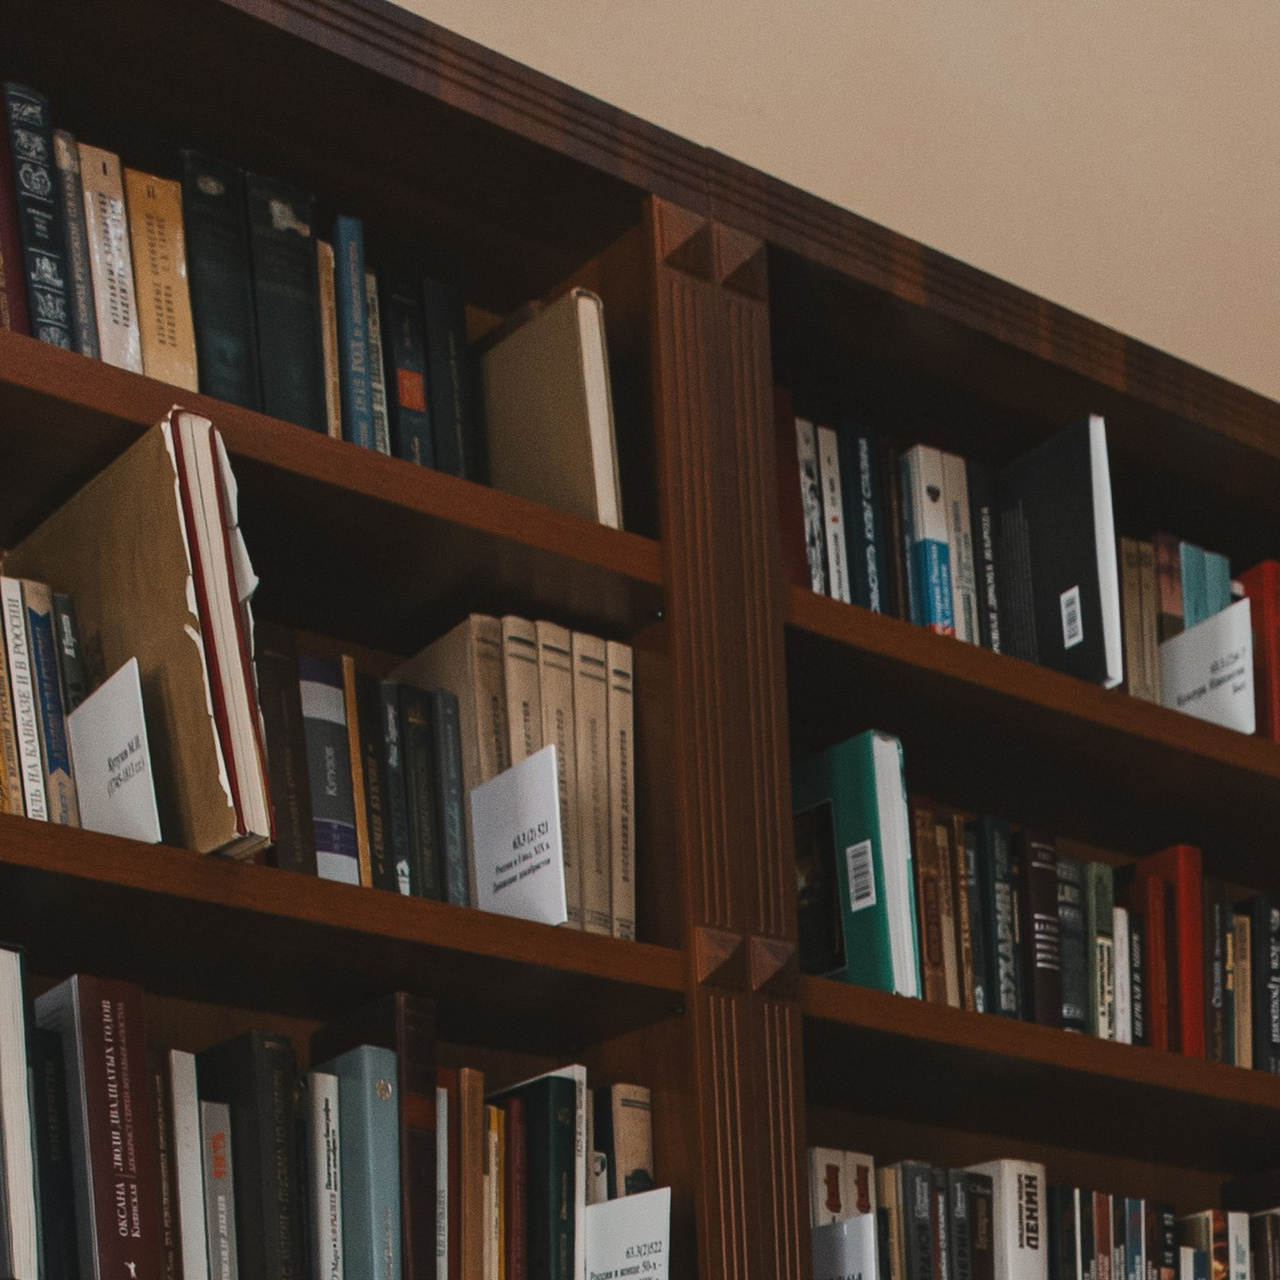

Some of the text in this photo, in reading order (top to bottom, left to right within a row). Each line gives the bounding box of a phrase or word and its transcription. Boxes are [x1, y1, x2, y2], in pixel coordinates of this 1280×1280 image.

[8, 598, 25, 656] РОССИИ
[13, 661, 27, 671] В
[15, 692, 37, 757] КАВКАЗЕ
[26, 764, 40, 783] НА
[995, 882, 1016, 1010] БУХАРИН
[102, 1000, 128, 1236] ОКСАНА ЛЮДИ ДВАДЦАТЫХ ГОДОВ
[1024, 1175, 1039, 1250] ЛЕНИН
